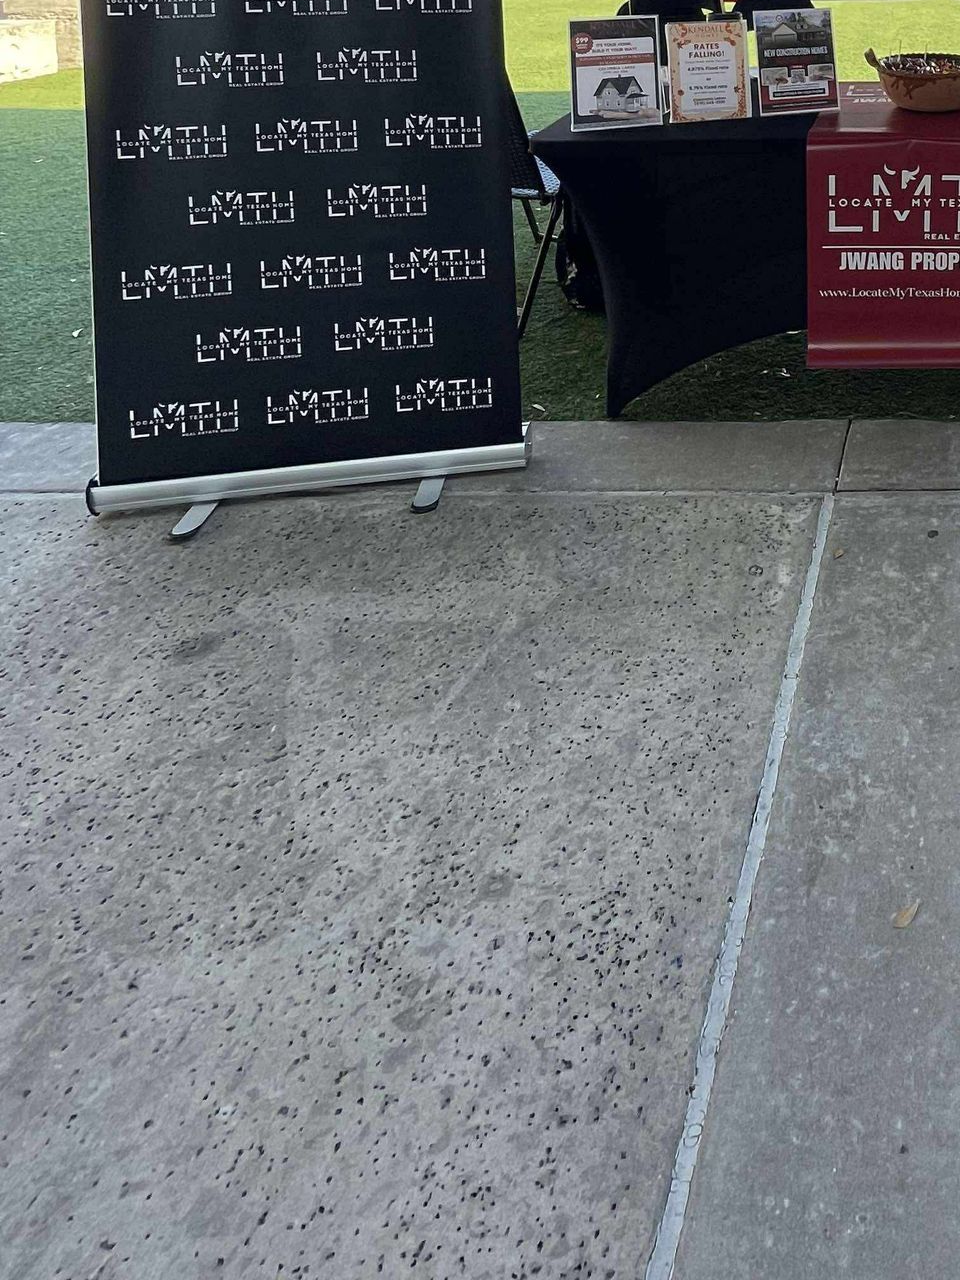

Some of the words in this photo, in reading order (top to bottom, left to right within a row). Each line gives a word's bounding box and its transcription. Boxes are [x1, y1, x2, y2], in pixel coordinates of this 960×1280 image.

[694, 43, 720, 51] RATES
[688, 51, 725, 59] FALLING!
[829, 198, 892, 207] LOCATE
[912, 198, 931, 207] MY
[839, 252, 904, 271] JWANG
